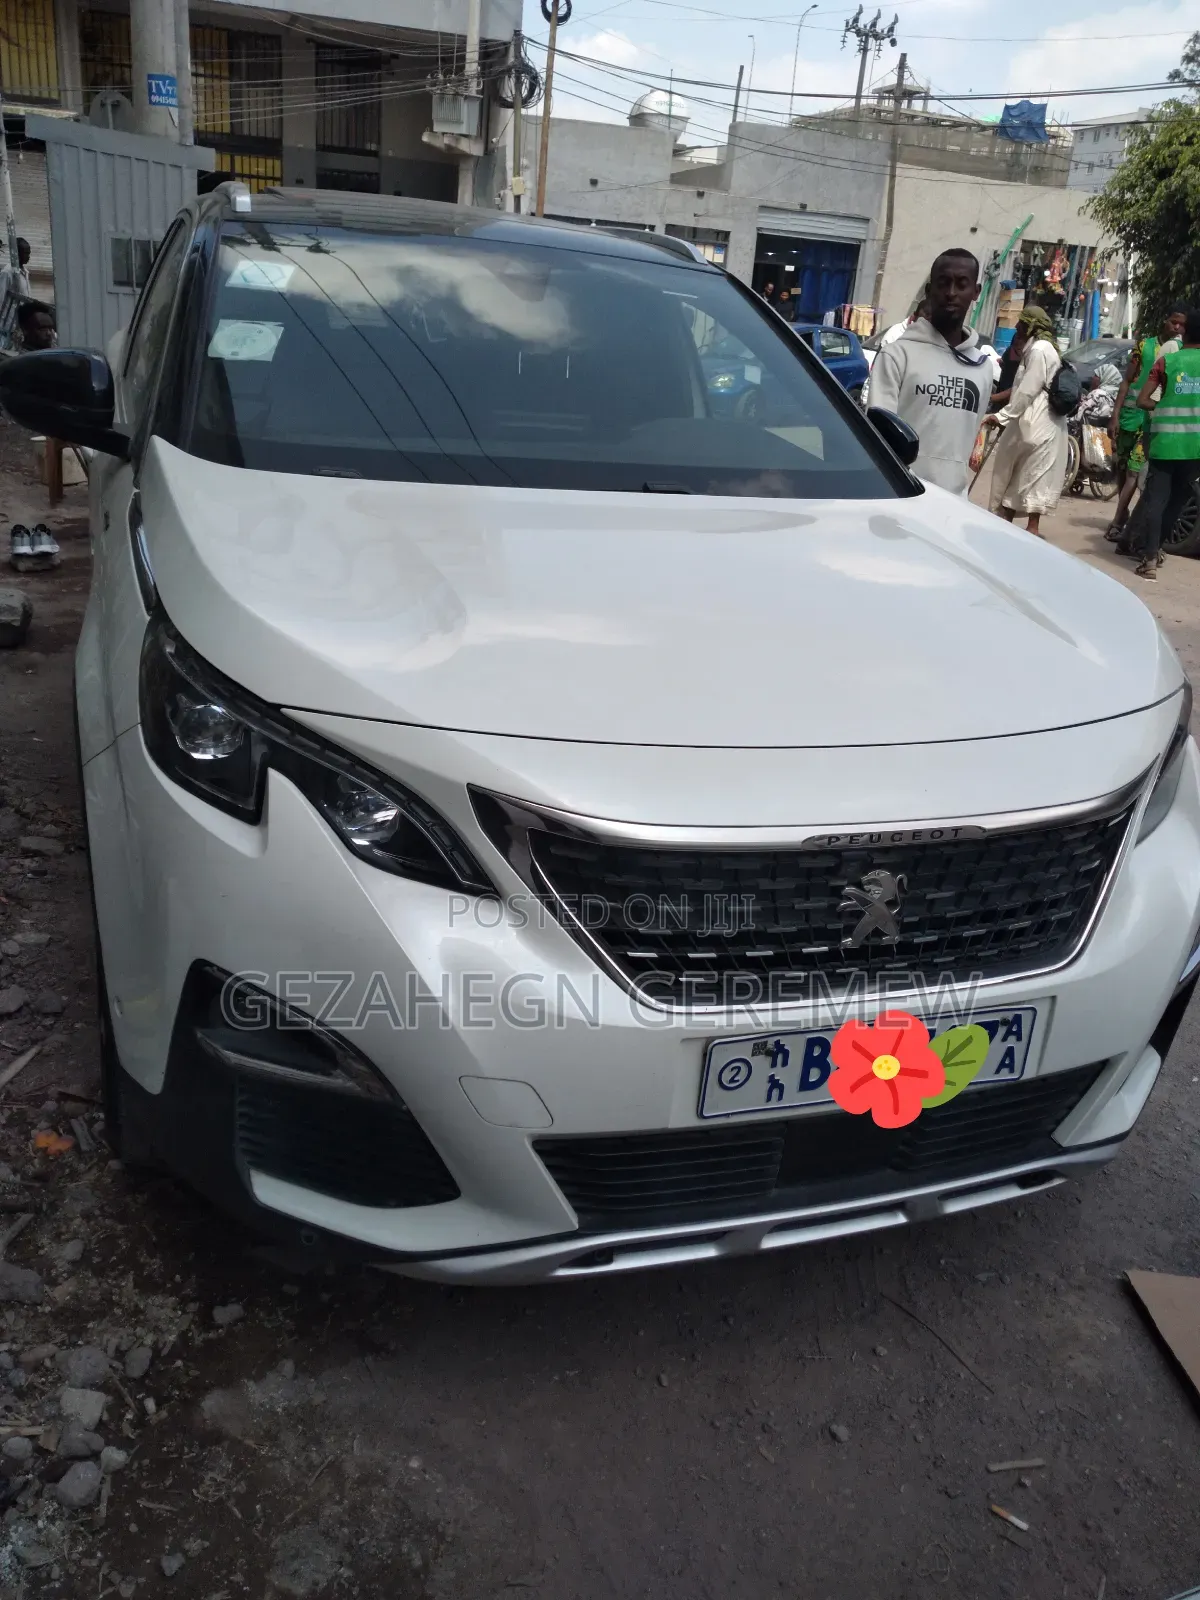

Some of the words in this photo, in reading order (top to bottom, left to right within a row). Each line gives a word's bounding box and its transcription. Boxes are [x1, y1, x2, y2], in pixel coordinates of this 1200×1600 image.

[148, 80, 169, 94] TV
[938, 374, 964, 388] THE
[915, 384, 963, 398] NORTH
[928, 395, 962, 409] FACE
[827, 827, 963, 846] PEUGEOT
[1001, 1013, 1023, 1043] A
[994, 1045, 1015, 1075] A
[728, 1065, 742, 1084] 2
